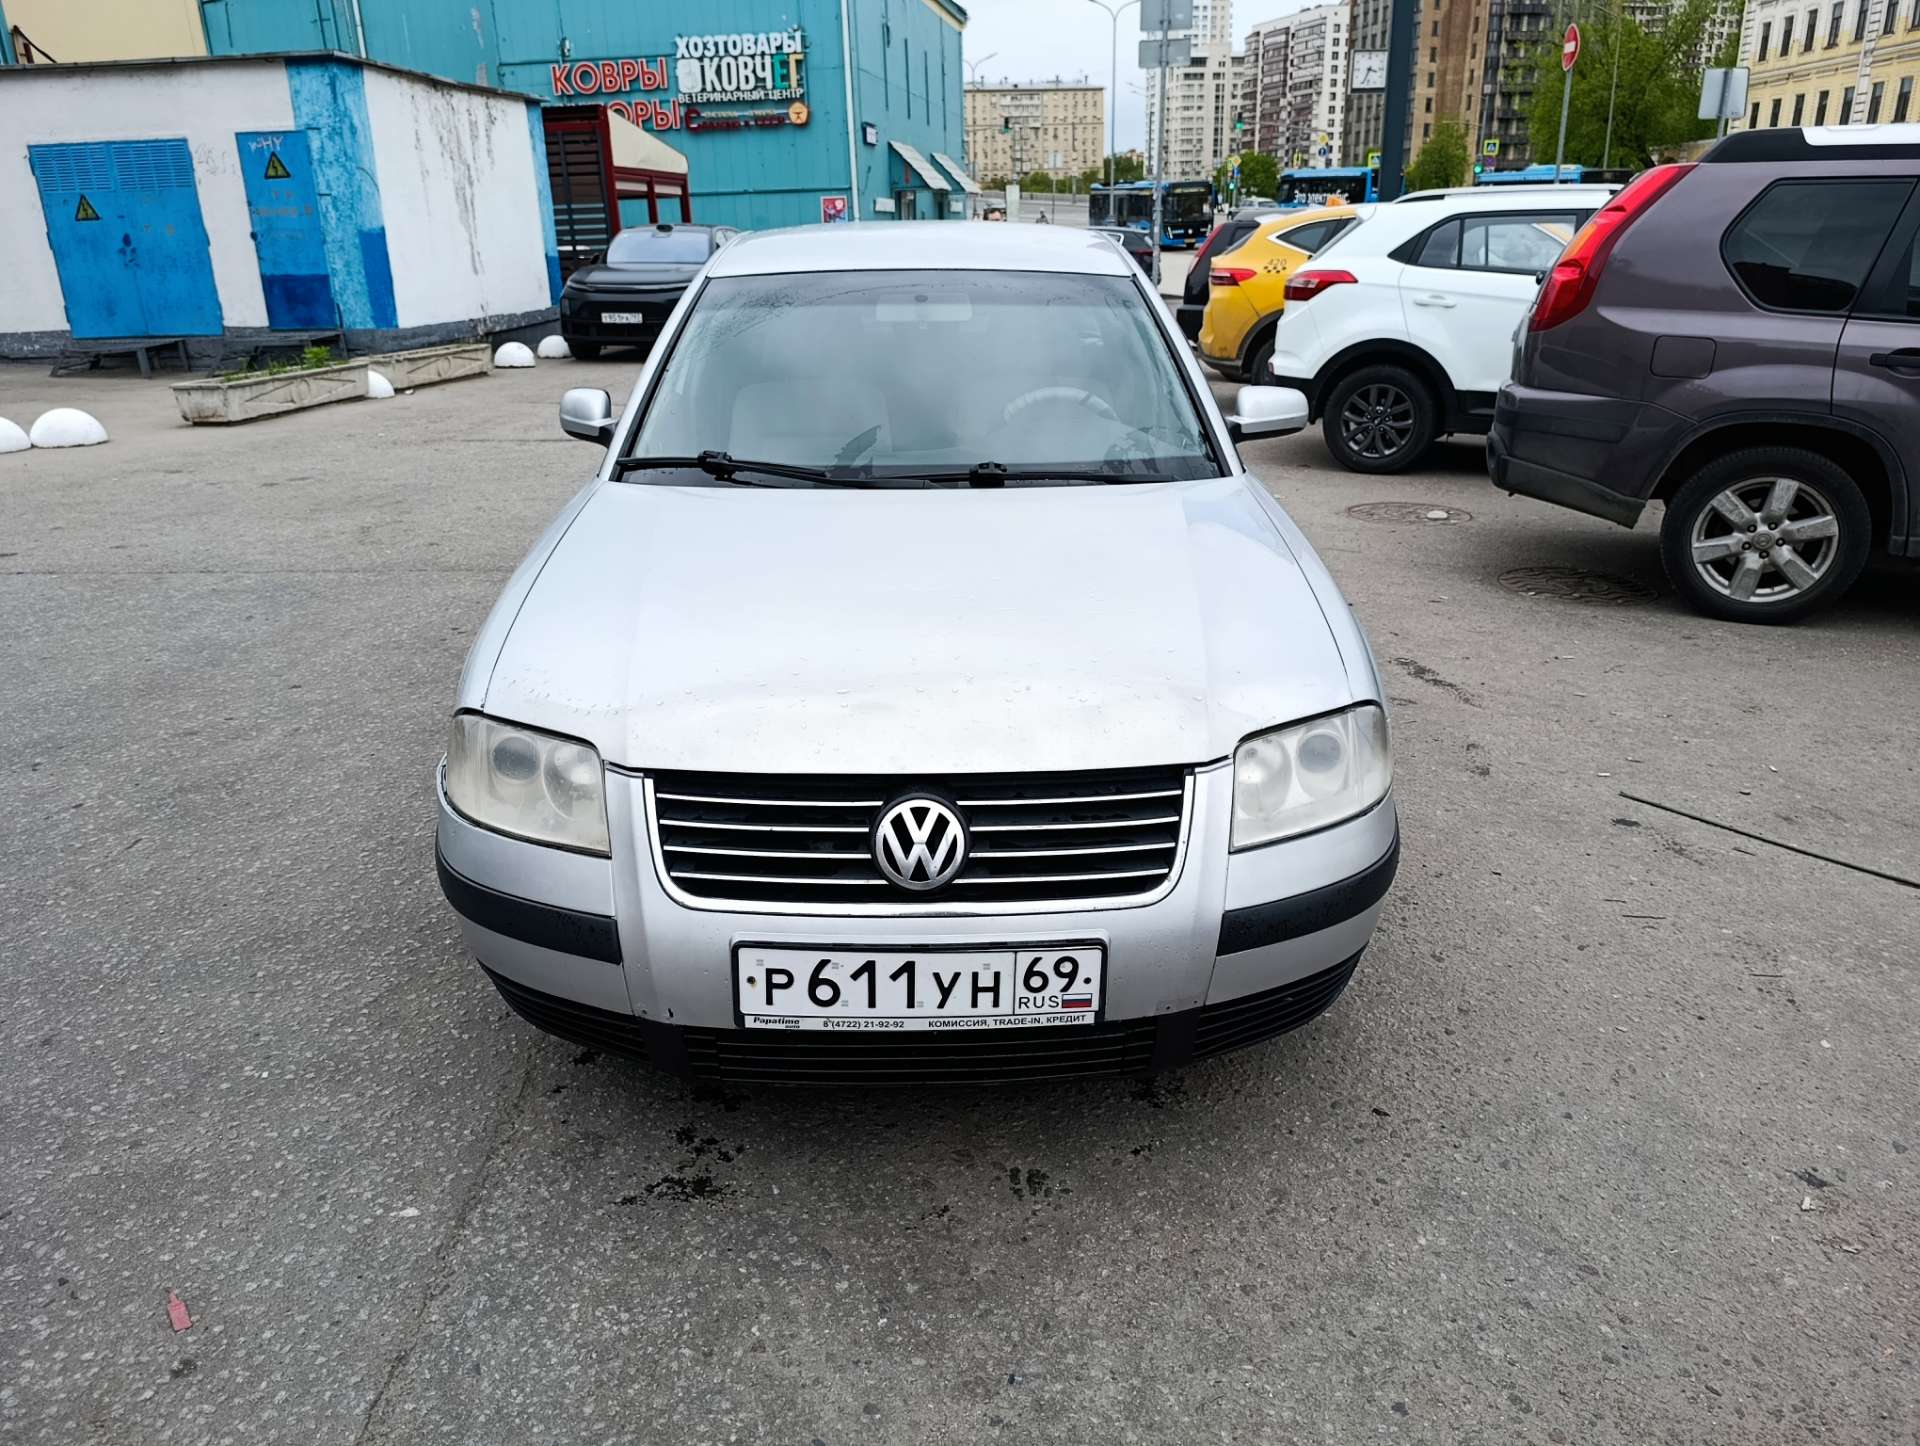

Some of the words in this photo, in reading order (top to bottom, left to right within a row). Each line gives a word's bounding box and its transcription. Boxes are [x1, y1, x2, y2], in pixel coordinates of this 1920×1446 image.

[675, 30, 802, 58] ХОЗТОВАРЫ
[551, 57, 668, 96] КОВРЫ
[703, 54, 804, 92] КОВЧЕГ
[678, 89, 765, 104] ВЕТЕРИНАРНЫЙ
[768, 88, 804, 101] ЦЕНТР
[765, 958, 1001, 1009] Р611УН
[1022, 955, 1079, 994] 69
[1018, 995, 1060, 1010] RUS
[753, 1016, 800, 1026] Papatime
[831, 1020, 861, 1029] (4722)
[864, 1020, 905, 1028] 21-92-92
[928, 1019, 990, 1028] КОМИССИЯ,
[1046, 1014, 1087, 1024] КРЕДИТ
